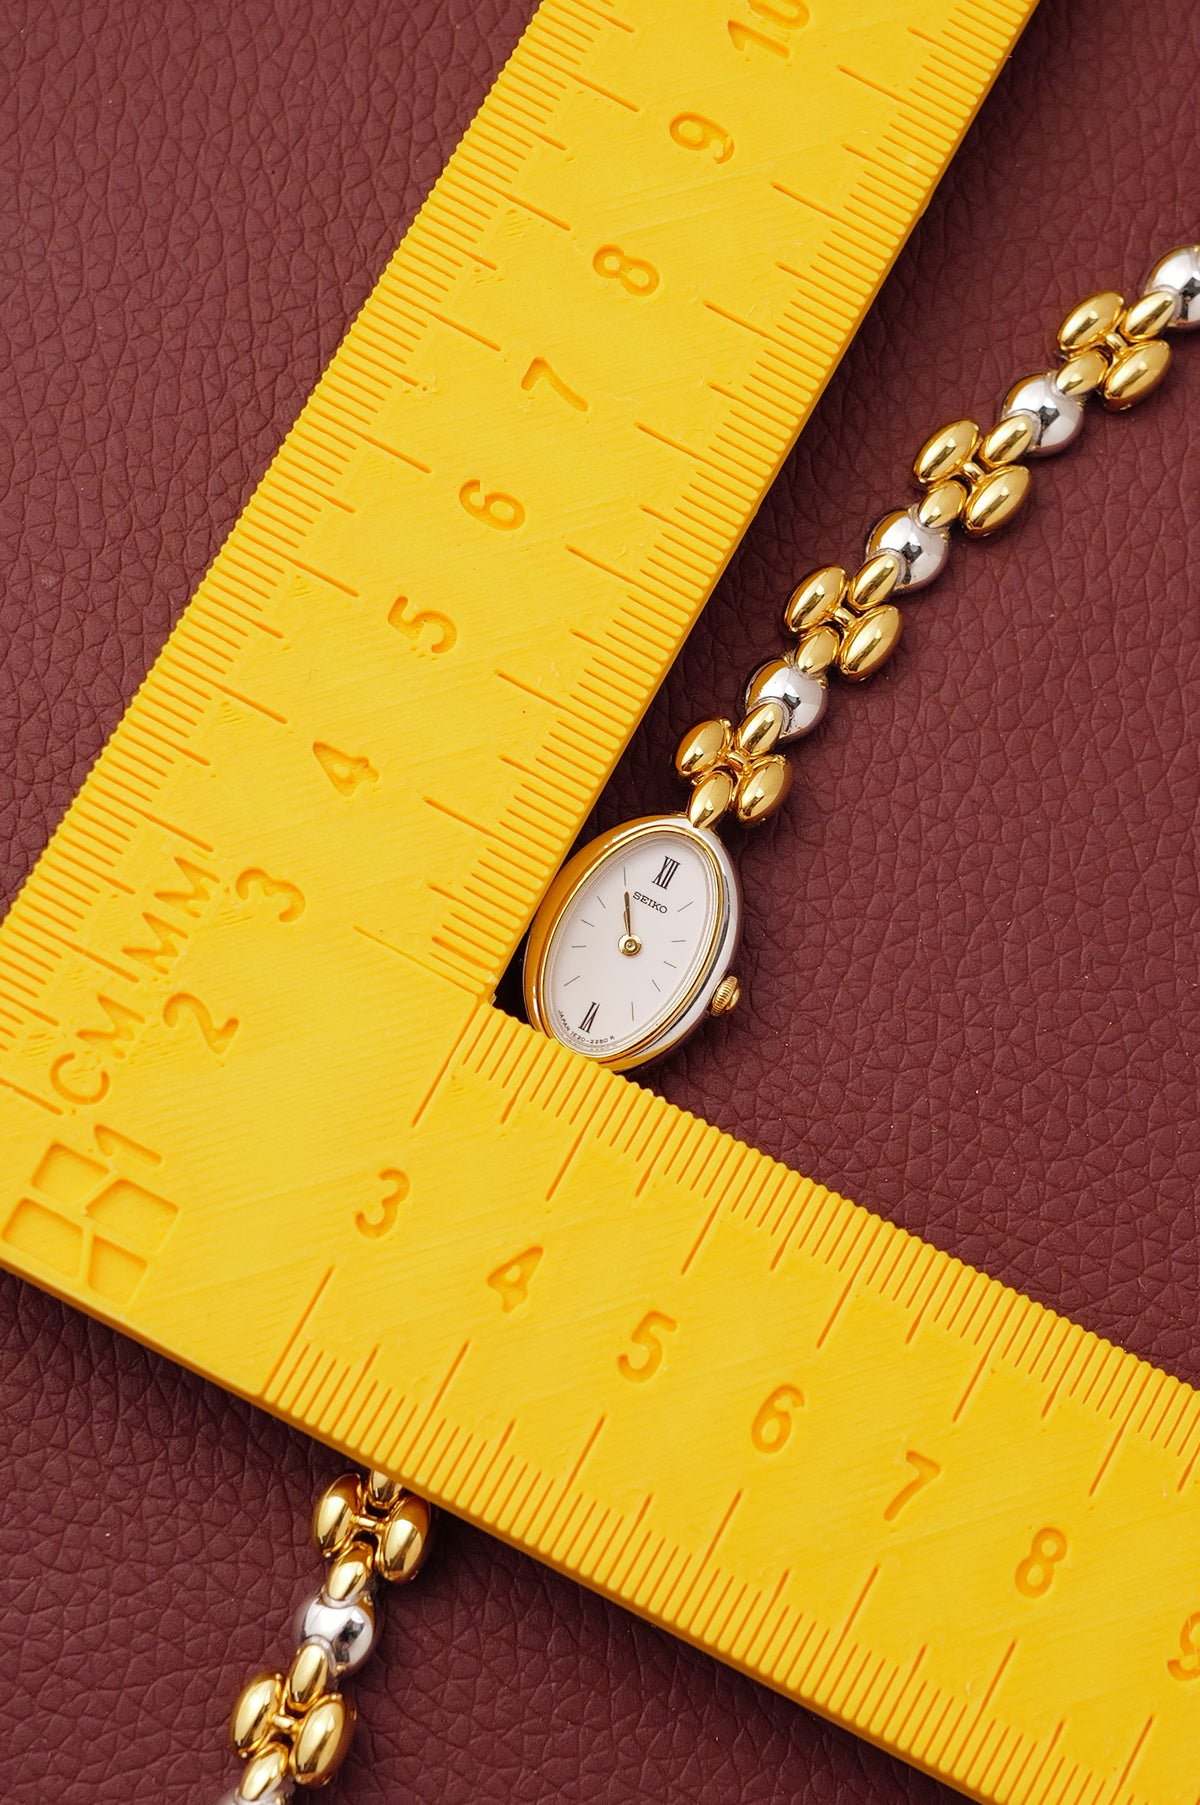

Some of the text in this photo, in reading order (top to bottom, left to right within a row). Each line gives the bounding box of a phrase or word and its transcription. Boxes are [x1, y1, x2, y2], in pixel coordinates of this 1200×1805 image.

[94, 0, 810, 1166] 1 2 3 4 5 6 7 8 9 10
[651, 856, 680, 890] XII
[632, 891, 668, 914] SEIKO
[558, 1010, 571, 1031] JAPAN
[355, 1167, 411, 1239] 3
[487, 1245, 544, 1313] 4
[618, 1310, 677, 1383] 5
[751, 1384, 805, 1453] 6
[883, 1450, 941, 1521] 7
[1014, 1526, 1067, 1599] 8
